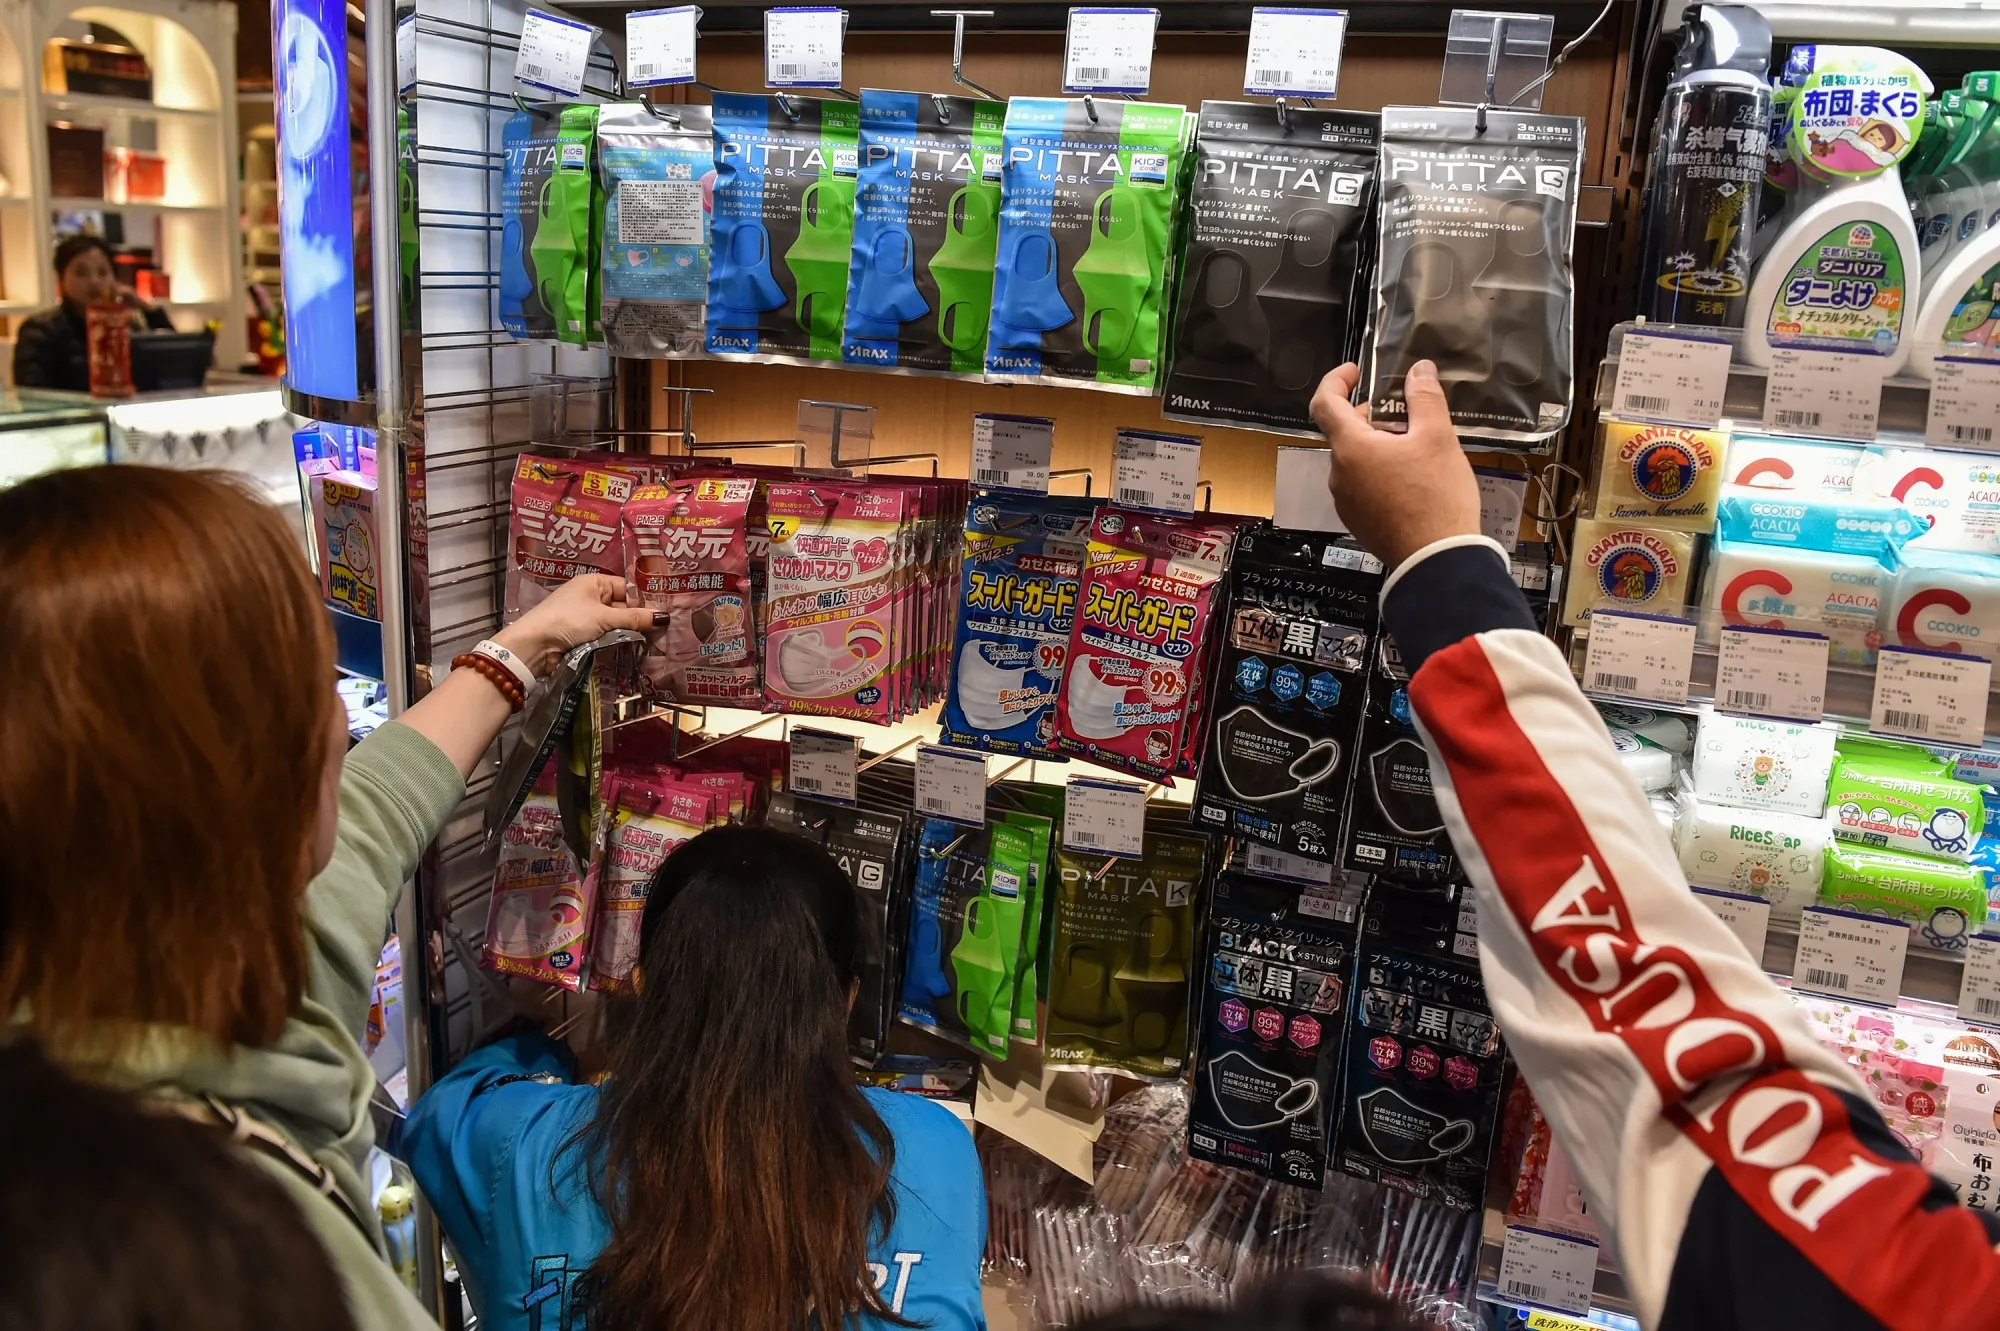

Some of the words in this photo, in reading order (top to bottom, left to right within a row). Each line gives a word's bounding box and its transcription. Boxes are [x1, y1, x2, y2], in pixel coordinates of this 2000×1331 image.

[1804, 90, 1918, 118] 布団・まくら
[1207, 121, 1249, 130] 花粉・かぜ用
[1685, 126, 1767, 155] 杀蟑气雾剂
[564, 148, 583, 156] KIDS
[720, 142, 828, 170] PITTA
[866, 145, 976, 174] PITTA
[1010, 147, 1124, 176] PITTA
[1292, 158, 1330, 166] ピッタ・マスク
[749, 167, 796, 177] MASK
[896, 170, 943, 181] MASK
[1203, 159, 1321, 192] PITTA
[1392, 157, 1526, 185] PITTA
[1541, 169, 1565, 189] G
[1040, 174, 1089, 185] MASK
[1334, 176, 1358, 195] G
[1431, 182, 1488, 191] MASK
[1233, 186, 1284, 198] MASK
[1197, 210, 1280, 224] 花粉の侵入を徹底ガード。
[1392, 204, 1489, 216] 花粉の侵入を徹底ガード。
[1820, 261, 1884, 276] ダニバリア
[1786, 280, 1875, 307] ダニよけ
[1876, 293, 1899, 306] スプレー
[1696, 301, 1726, 314] 无香
[714, 335, 750, 348] ARAX
[853, 345, 888, 359] ARAX
[997, 356, 1032, 369] ARAX
[1180, 396, 1211, 412] ARAX
[1620, 427, 1676, 461] CHANTE
[1679, 429, 1713, 469] CLAIR
[590, 477, 599, 488] S
[607, 486, 623, 499] 145
[1172, 492, 1191, 500] 39.00
[523, 498, 551, 511] PM2.5
[1610, 504, 1647, 518] Savon
[1648, 502, 1708, 517] Marseille
[1750, 503, 1804, 518] CCOKIO
[1914, 497, 1949, 508] CCOKIO
[853, 505, 881, 518] Pink
[636, 515, 665, 526] PM2.5
[1750, 518, 1801, 531] ACACIA
[517, 507, 616, 554] 三次元
[634, 528, 735, 560] 三次元
[795, 536, 849, 555] 快適ガード
[968, 536, 993, 552] New!
[546, 546, 579, 559] マスク
[855, 551, 883, 565] Pink
[974, 544, 1014, 565] PM2.5
[1090, 550, 1114, 563] New!
[1200, 541, 1221, 564] 7枚入
[1327, 548, 1361, 560] レギュラー
[1587, 533, 1642, 566] CHANTE
[1644, 538, 1677, 576] CLAIR
[666, 561, 699, 570] マスク
[772, 558, 852, 579] さわやかマスク
[1018, 557, 1079, 576] カゼ&花粉
[1094, 561, 1138, 577] PM2.5
[1364, 559, 1382, 568] サイズ
[1174, 567, 1203, 581] 1週間分
[646, 573, 724, 592] 高快適&高機能
[1138, 574, 1198, 599] カゼ&花粉
[1241, 571, 1368, 604] ブラック×スタイリッシュ
[773, 583, 886, 619] ふんわり幅広耳ひも
[967, 572, 1078, 618] スーパーガード
[1826, 592, 1878, 607] ACACIA
[1084, 583, 1195, 639] スーパーガード
[1748, 596, 1796, 617] 多機能
[1237, 614, 1281, 640] 立体
[1927, 620, 1980, 636] CCOKIO
[699, 637, 746, 657] 口もとゆったり
[1283, 622, 1315, 656] 黒
[1320, 635, 1360, 656] マスク
[1166, 643, 1190, 655] マスク
[829, 667, 877, 692] つるさら素材
[1149, 670, 1186, 694] 99%
[1242, 668, 1261, 681] 立体
[1275, 676, 1298, 692] 99%
[857, 689, 878, 698] PM2.5
[1309, 688, 1336, 701] ブラック
[789, 700, 883, 718] 99%カットフィルター
[1946, 716, 1966, 725] 15.00
[1880, 780, 1974, 804] 台所用せっけん
[670, 806, 690, 820] Pink
[1203, 806, 1225, 820] 日本製
[621, 827, 663, 850] 快適ガード
[1297, 834, 1328, 856] 5枚入
[1358, 847, 1384, 859] 日本製
[861, 863, 880, 881] G
[1398, 857, 1446, 872] 携帯に便利
[933, 871, 966, 888] MASK
[994, 872, 1017, 886] KIDS
[1837, 870, 1875, 886] シャボン玉
[1169, 881, 1188, 899] K
[1878, 876, 1974, 901] 台所用せっけん
[1087, 891, 1130, 903] MASK
[1302, 897, 1331, 910] 小さめ
[1221, 917, 1344, 950] ブラック×スタイリッシュ
[1219, 932, 1298, 961] BLACK
[552, 954, 570, 963] PM2.5
[497, 957, 572, 983] 99%カットフィルター
[1262, 968, 1293, 1000] 黒
[1369, 967, 1451, 1001] BLACK
[1865, 976, 1886, 986] 25.00
[1300, 980, 1338, 1001] マスク
[1225, 1008, 1244, 1021] 立体
[1416, 1005, 1449, 1040] 黒
[1257, 1017, 1280, 1032] 99%
[1454, 1020, 1492, 1042] マスク
[1291, 1031, 1318, 1041] ブラック
[1055, 1048, 1084, 1059] ARAX
[1375, 1046, 1397, 1060] 立体
[1410, 1055, 1434, 1071] 99%
[1194, 1134, 1216, 1149] 日本製
[1288, 1163, 1317, 1181] 5枚入
